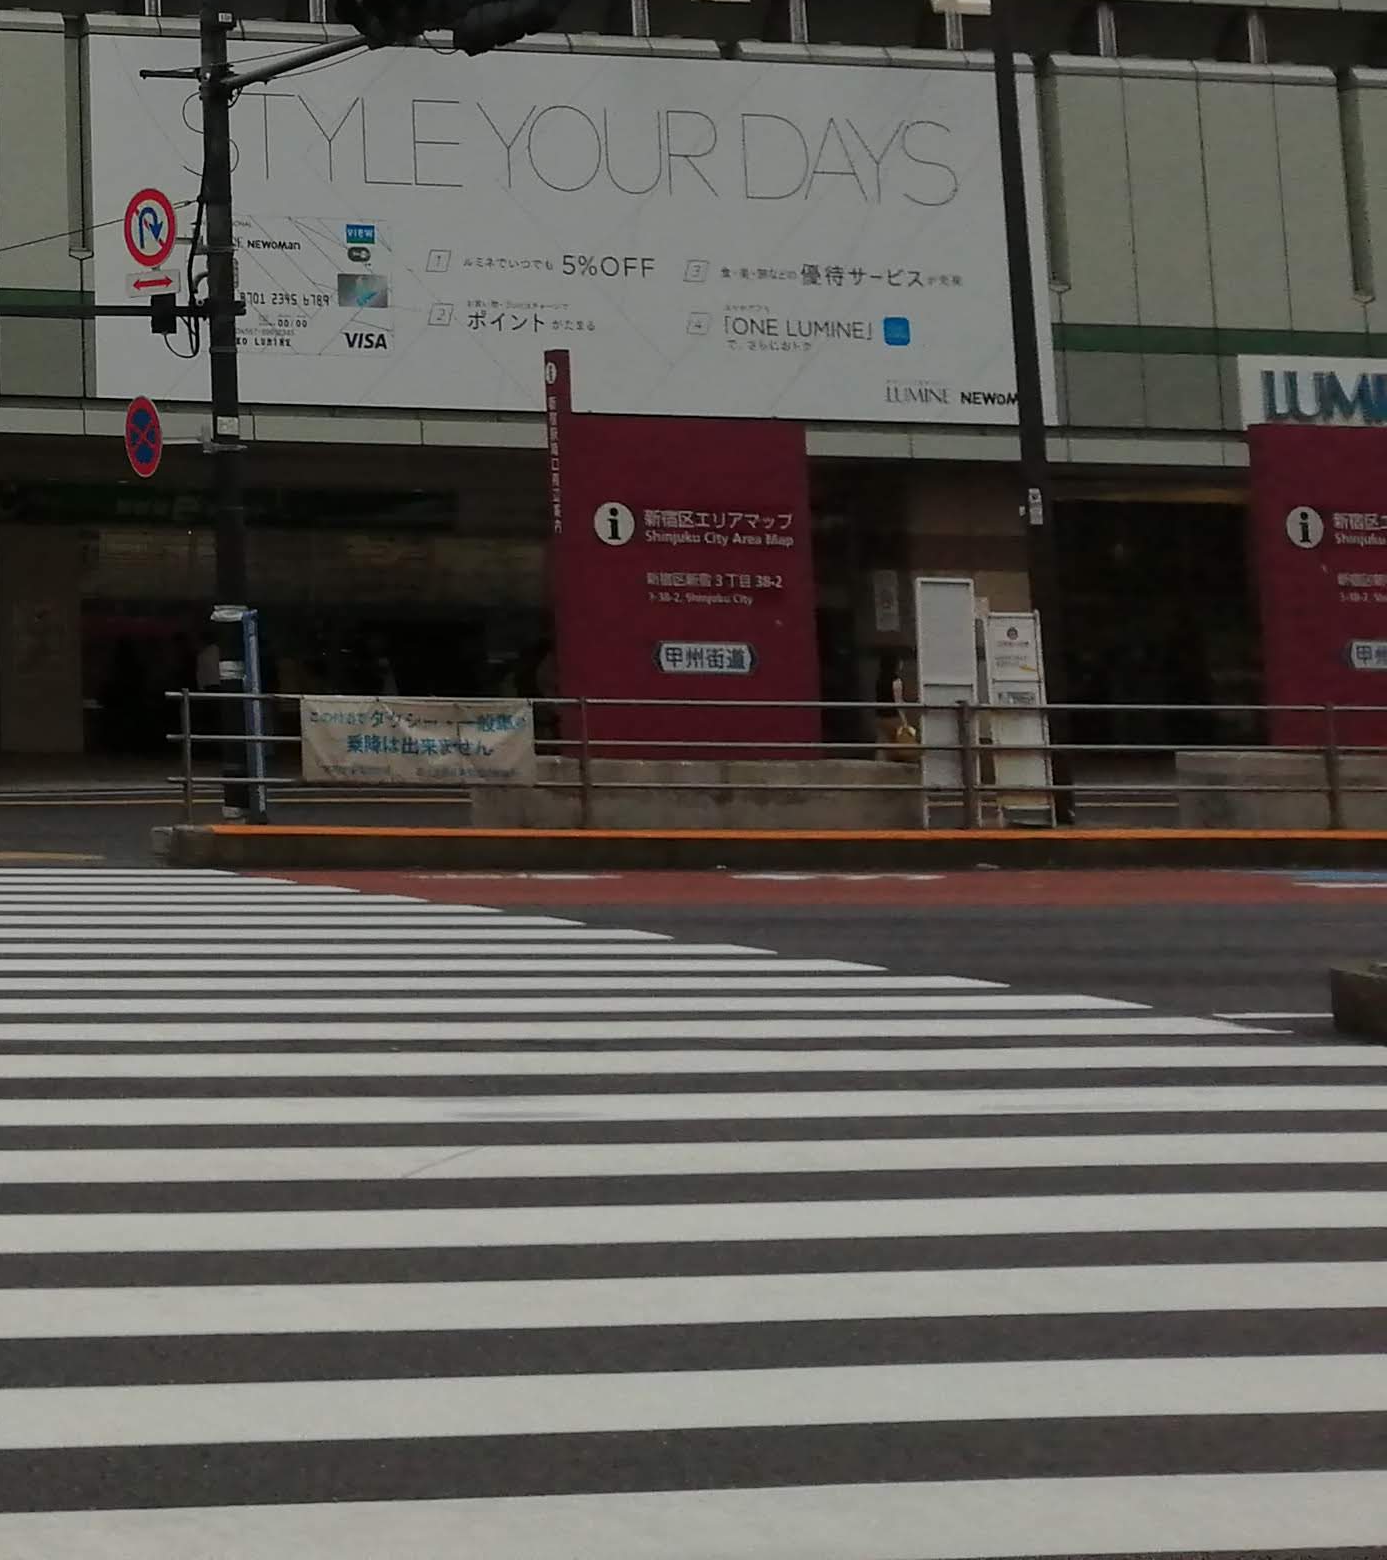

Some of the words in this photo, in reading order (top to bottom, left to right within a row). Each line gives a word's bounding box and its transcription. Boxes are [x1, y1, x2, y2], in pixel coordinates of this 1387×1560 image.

[476, 101, 720, 199] YOUR
[741, 112, 960, 208] DAYS
[562, 254, 656, 278] 5%OFF
[344, 332, 388, 350] VISA
[704, 530, 729, 548] City
[732, 533, 762, 547] Area
[664, 646, 747, 671] 甲州街道
